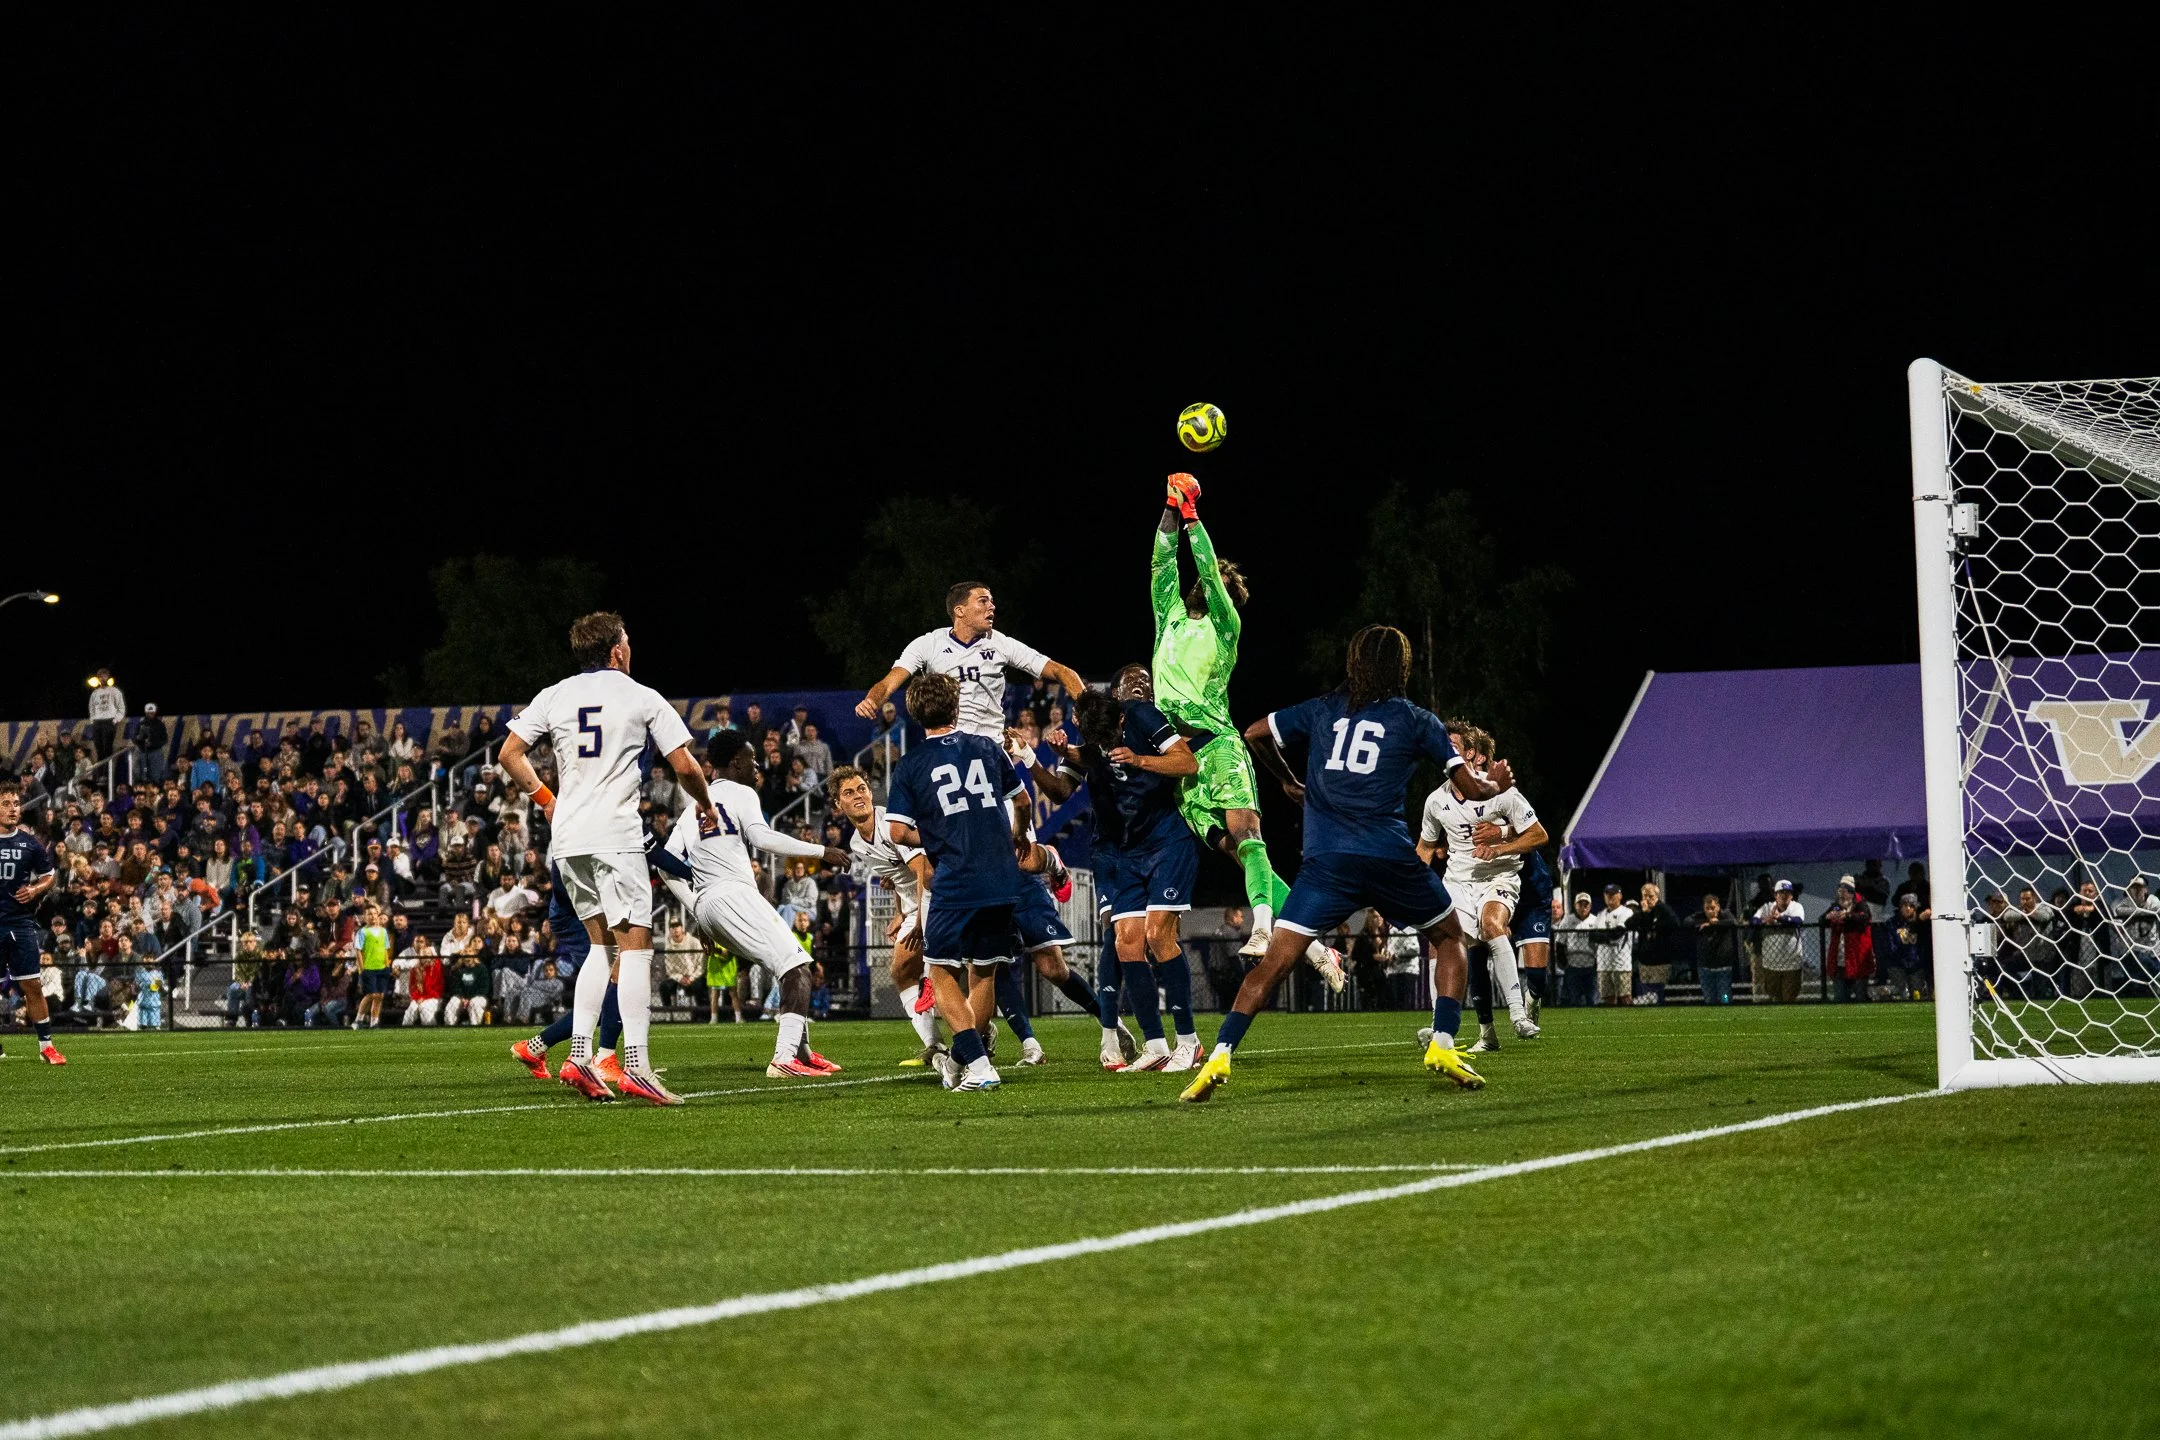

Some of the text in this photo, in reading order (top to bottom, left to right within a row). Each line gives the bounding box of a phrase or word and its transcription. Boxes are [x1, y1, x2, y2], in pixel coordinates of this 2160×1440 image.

[979, 650, 995, 660] W
[959, 666, 980, 682] 10
[578, 705, 603, 758] 5
[1324, 717, 1386, 774] 16
[930, 758, 998, 817] 24
[0, 849, 22, 860] SU
